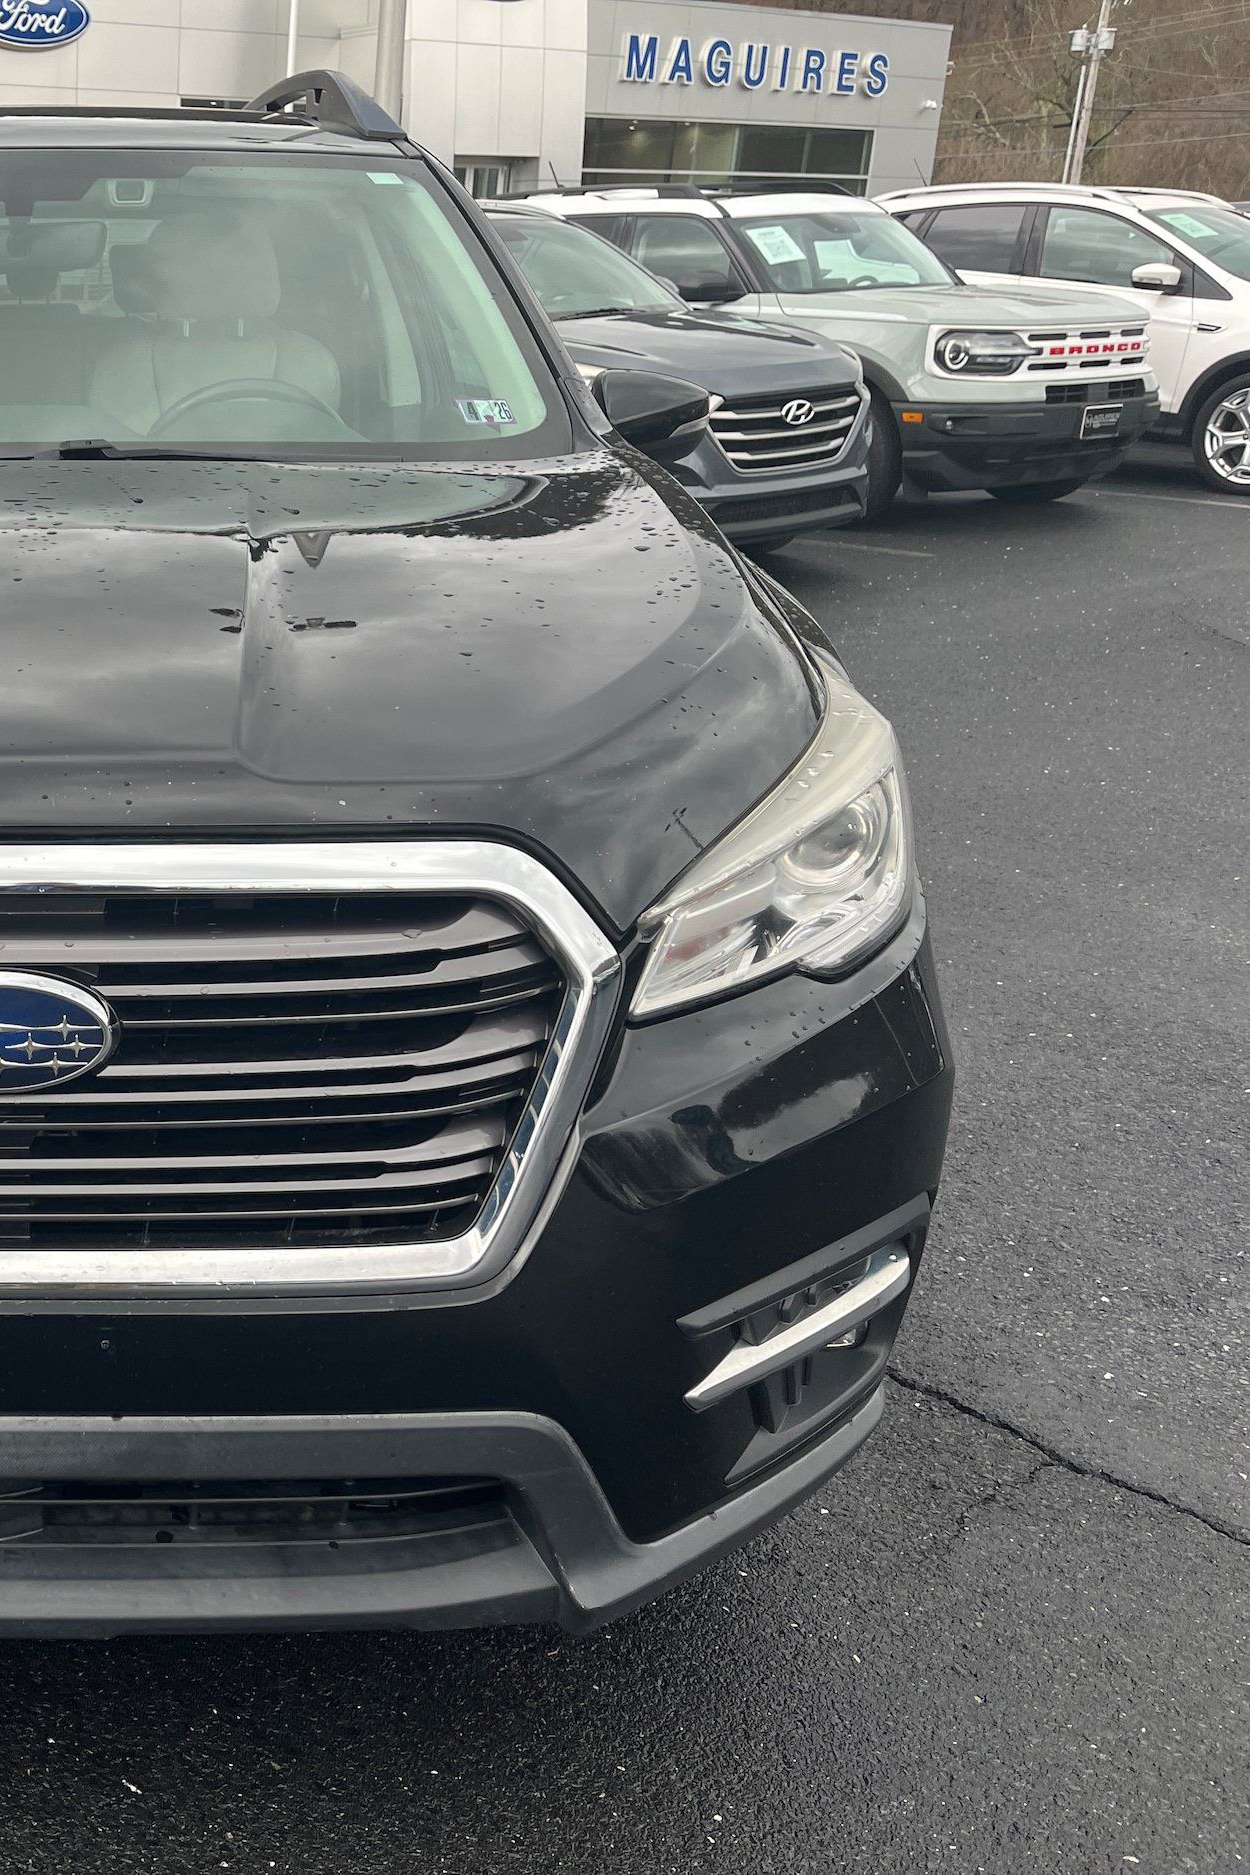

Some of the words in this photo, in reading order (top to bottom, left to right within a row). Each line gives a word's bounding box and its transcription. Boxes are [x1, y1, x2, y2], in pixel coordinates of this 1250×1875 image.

[624, 34, 890, 97] MAGUIRES
[1049, 342, 1141, 356] BRONCO
[493, 402, 512, 420] 26
